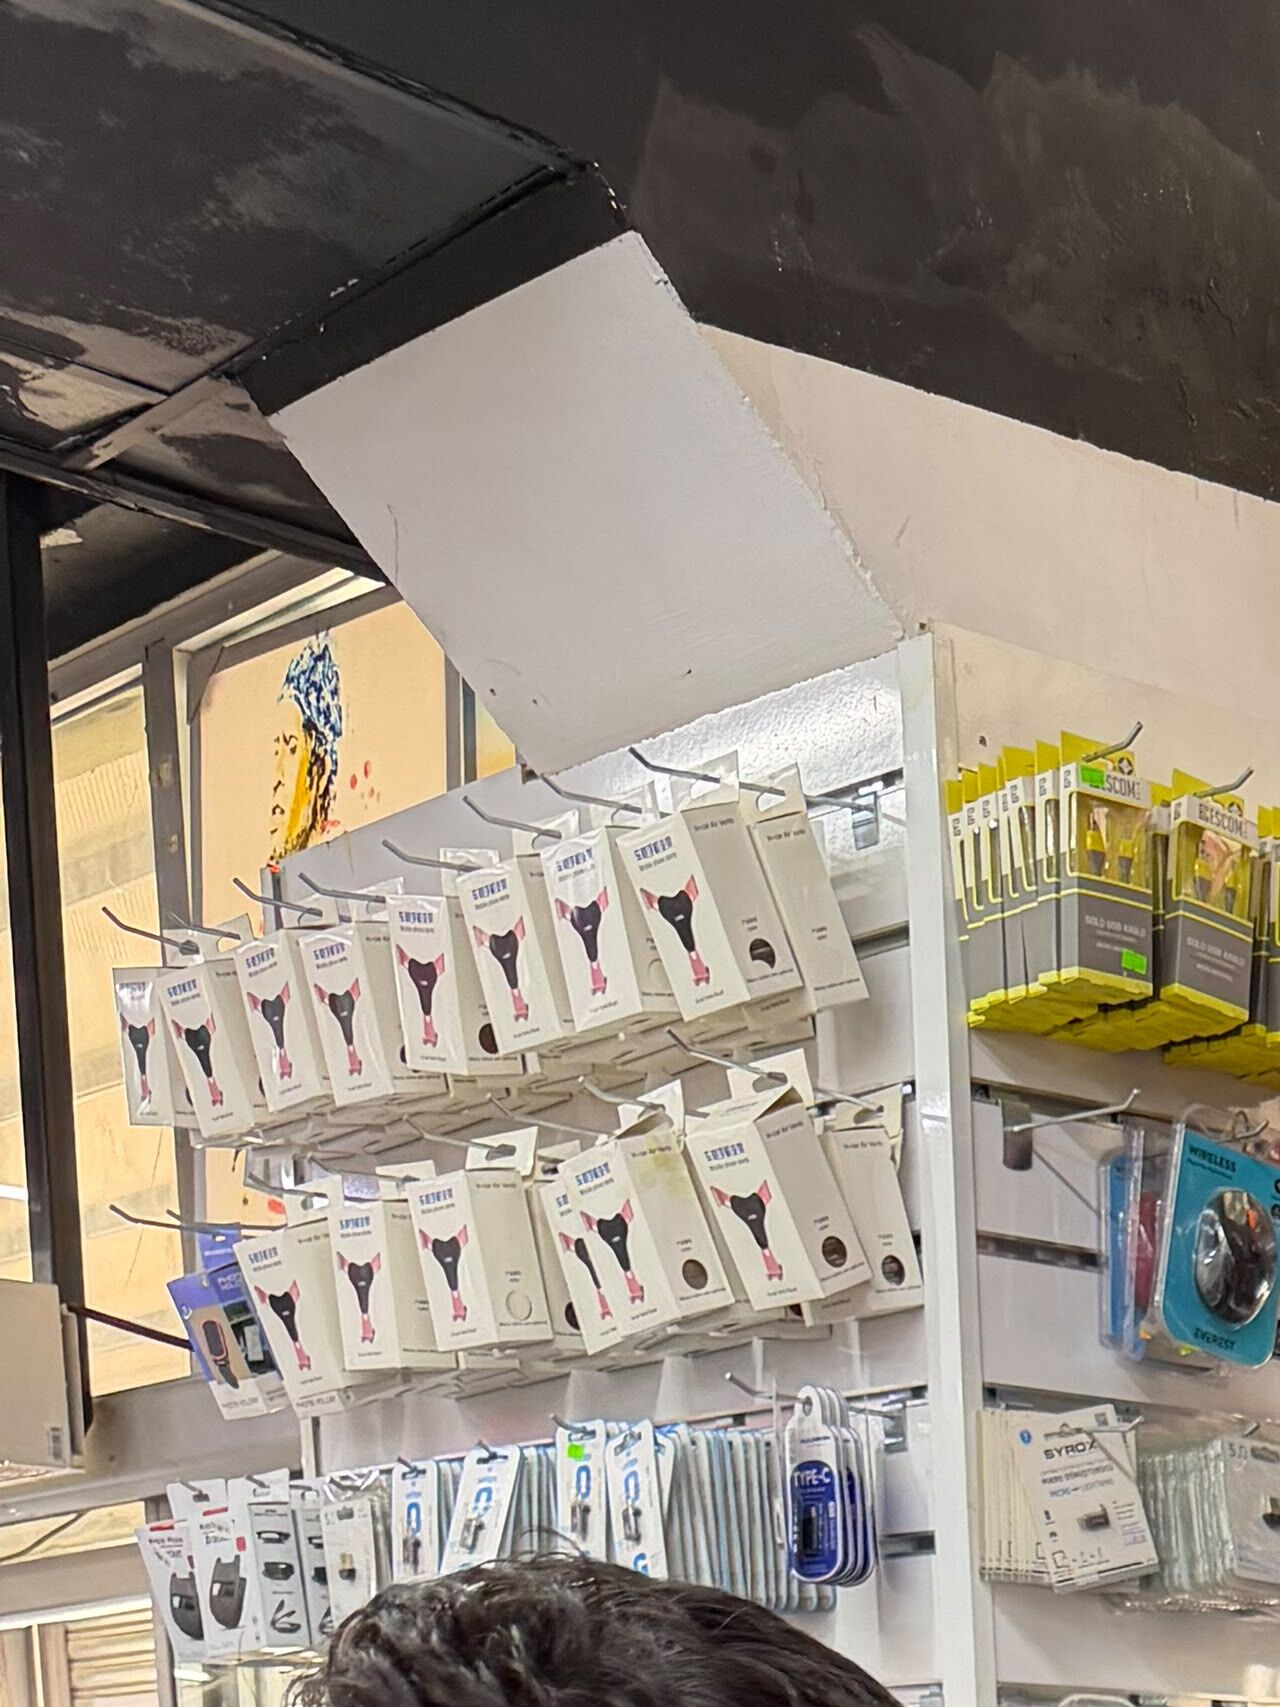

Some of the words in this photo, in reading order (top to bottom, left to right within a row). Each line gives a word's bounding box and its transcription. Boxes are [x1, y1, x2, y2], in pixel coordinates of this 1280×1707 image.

[1188, 1144, 1237, 1174] WIRELESS
[1043, 1439, 1098, 1461] SYROX
[791, 1468, 831, 1488] TYPE-C
